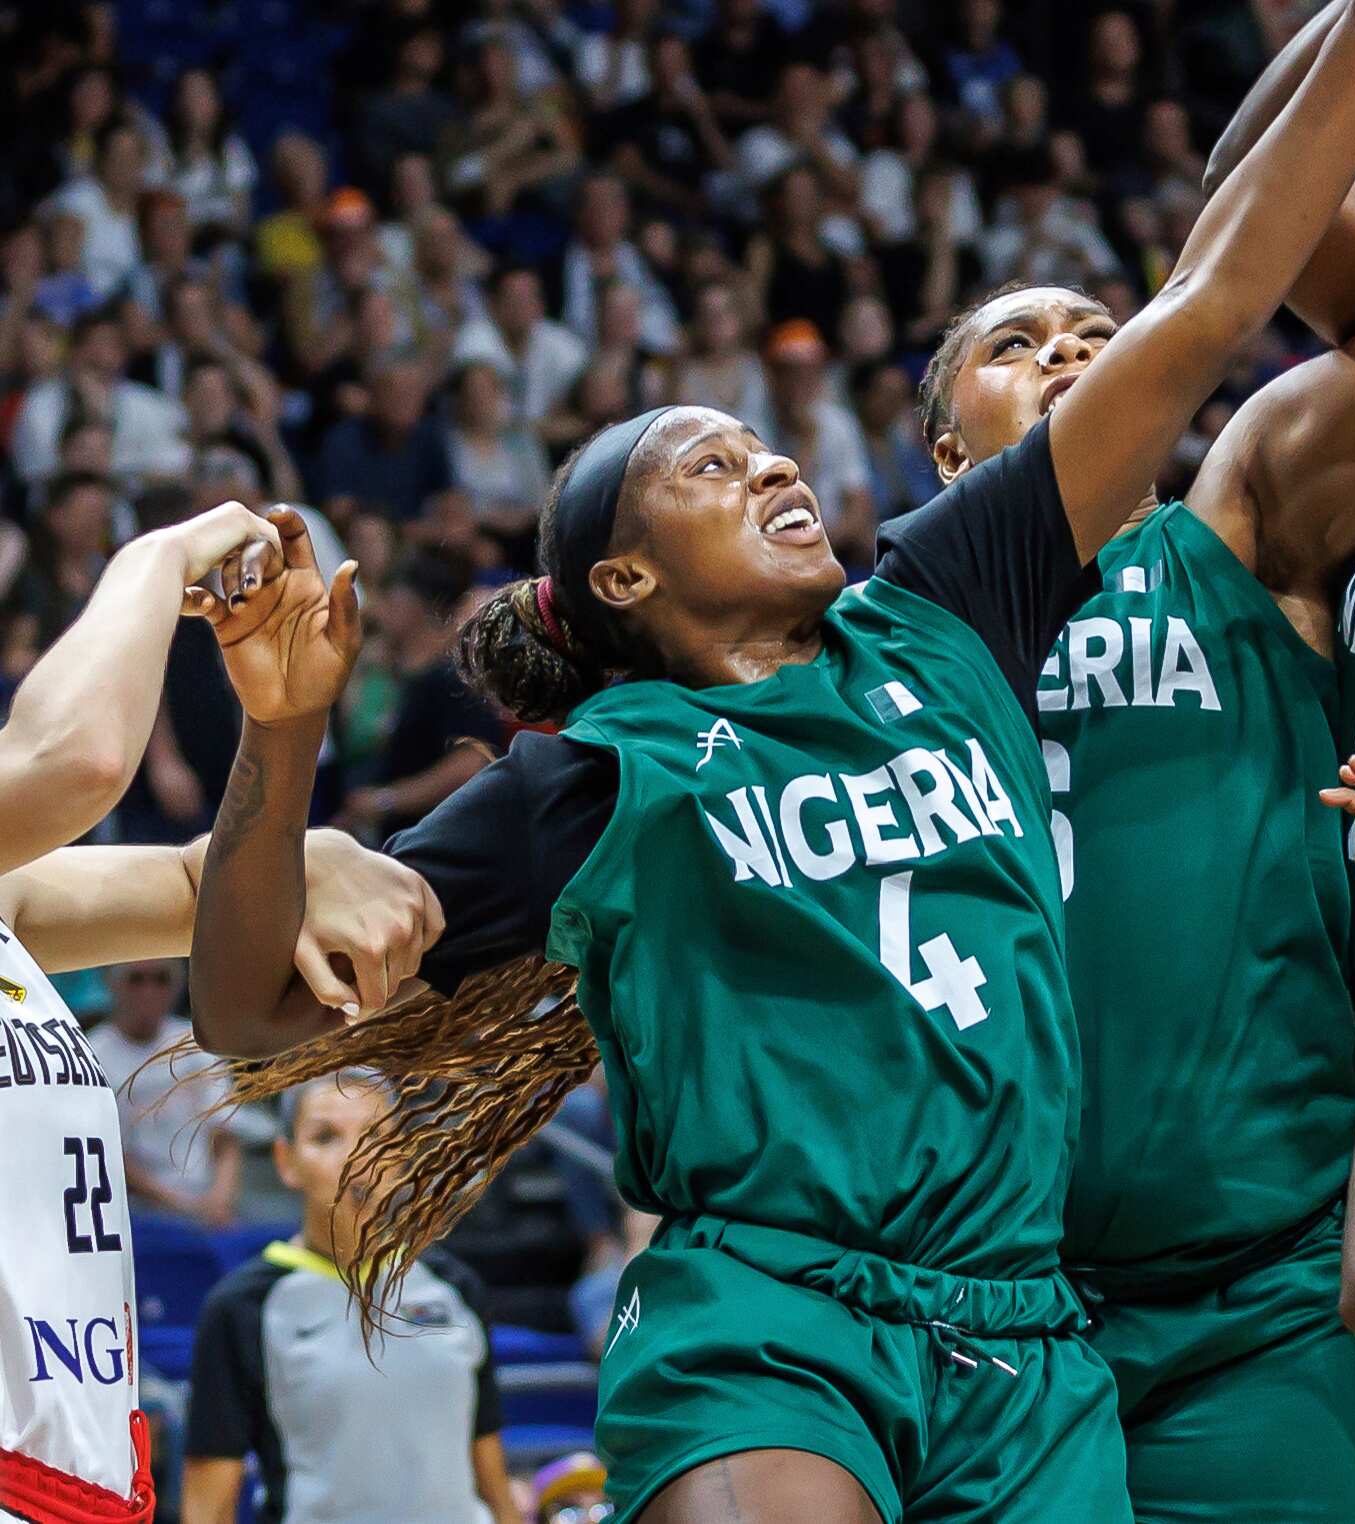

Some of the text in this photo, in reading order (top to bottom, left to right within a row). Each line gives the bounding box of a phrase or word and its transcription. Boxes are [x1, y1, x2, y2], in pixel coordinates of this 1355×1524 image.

[704, 738, 1024, 889] NIGERIA
[879, 869, 990, 1031] 4
[63, 1136, 122, 1253] 22
